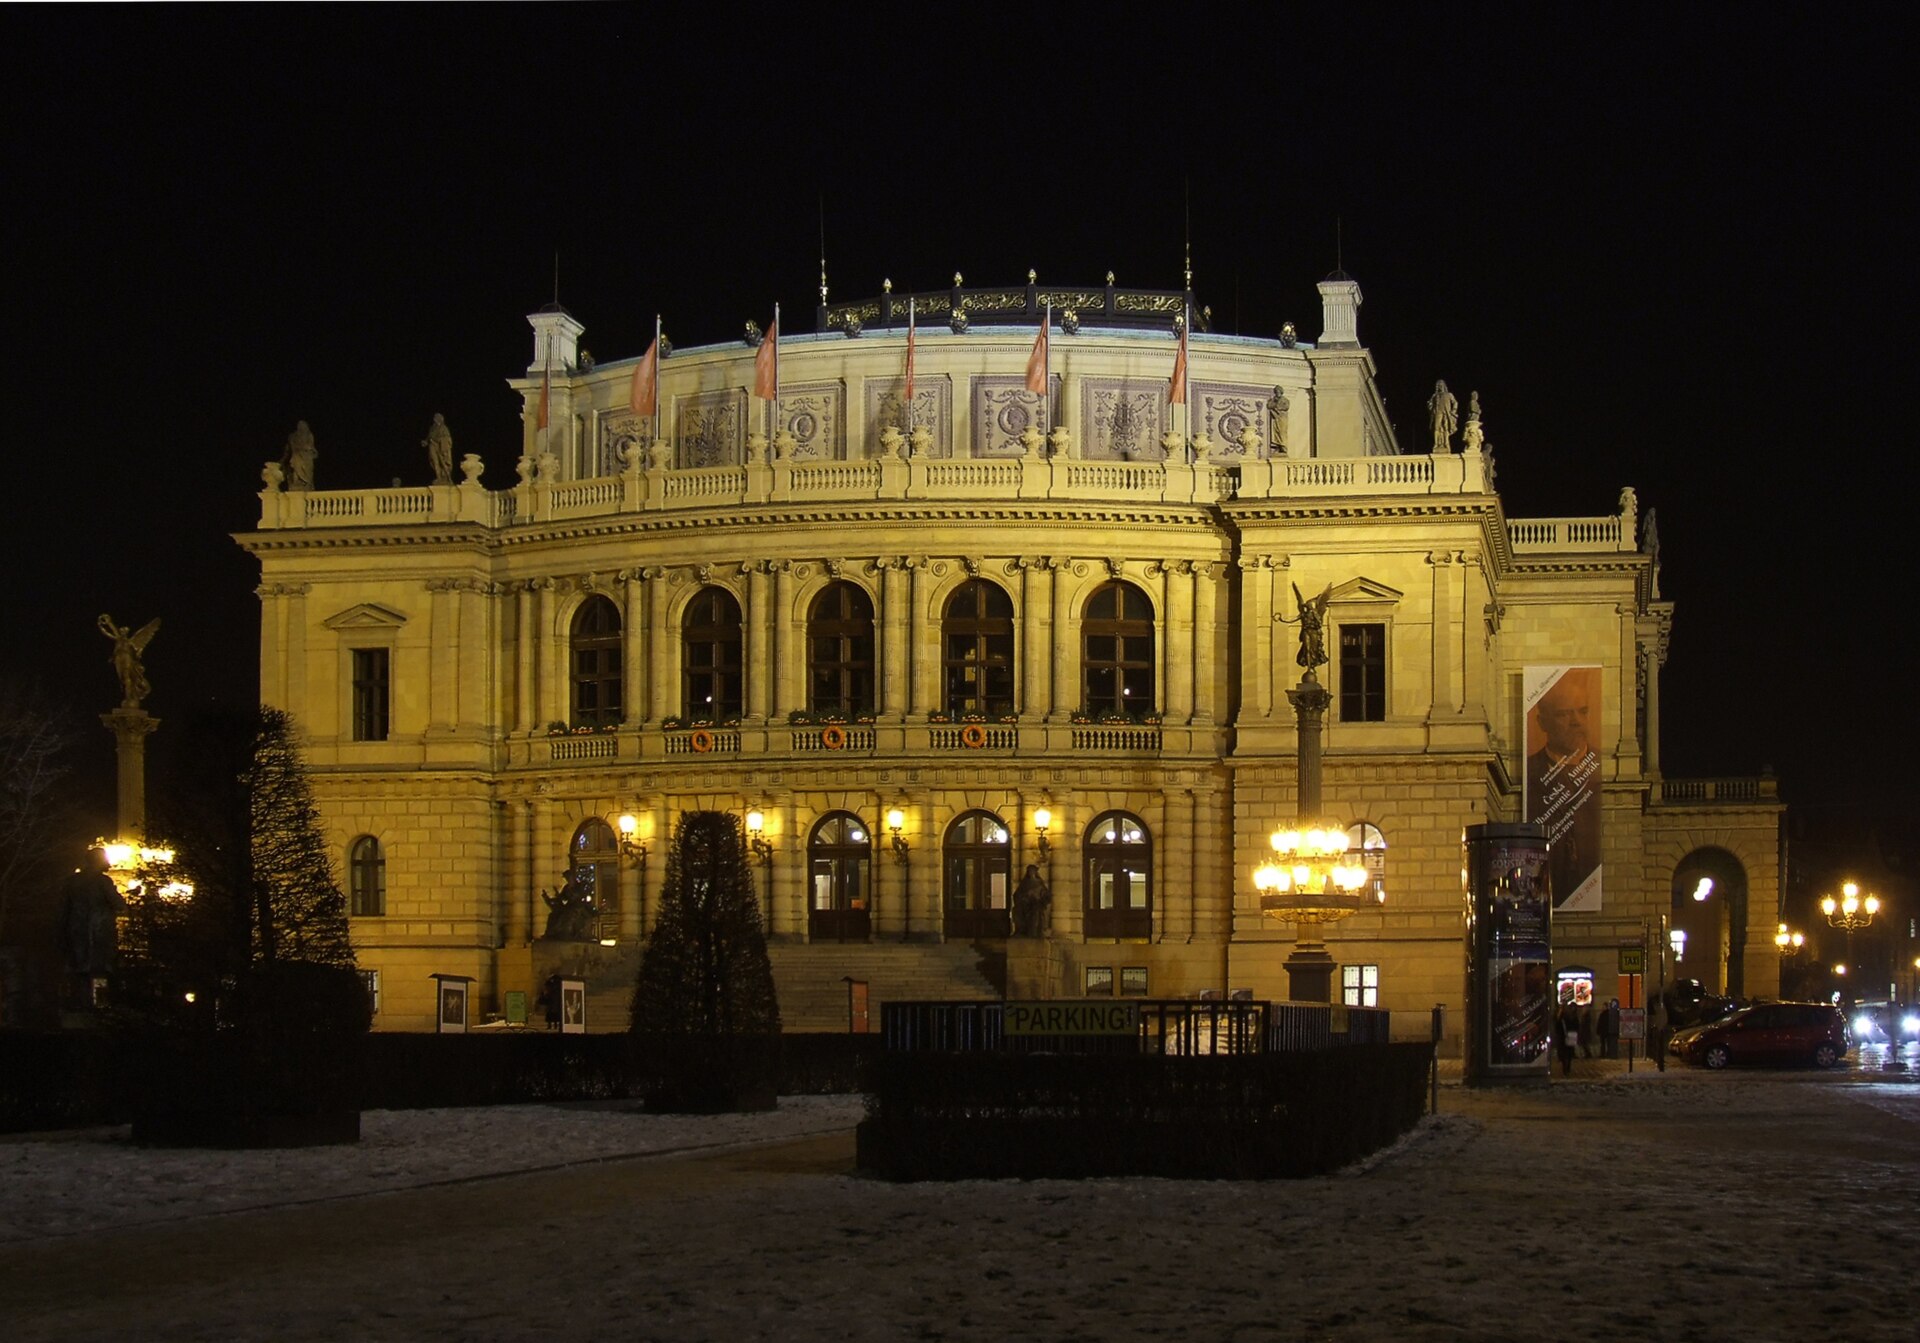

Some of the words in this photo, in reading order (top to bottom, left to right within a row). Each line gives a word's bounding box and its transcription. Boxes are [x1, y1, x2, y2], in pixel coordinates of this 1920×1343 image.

[1568, 751, 1596, 781] Antonín
[1573, 761, 1600, 787] Dvořák
[1543, 782, 1566, 805] Česká
[1534, 790, 1570, 824] lharmonie
[1624, 956, 1640, 966] TAXI
[1015, 1006, 1125, 1031] PARKING
